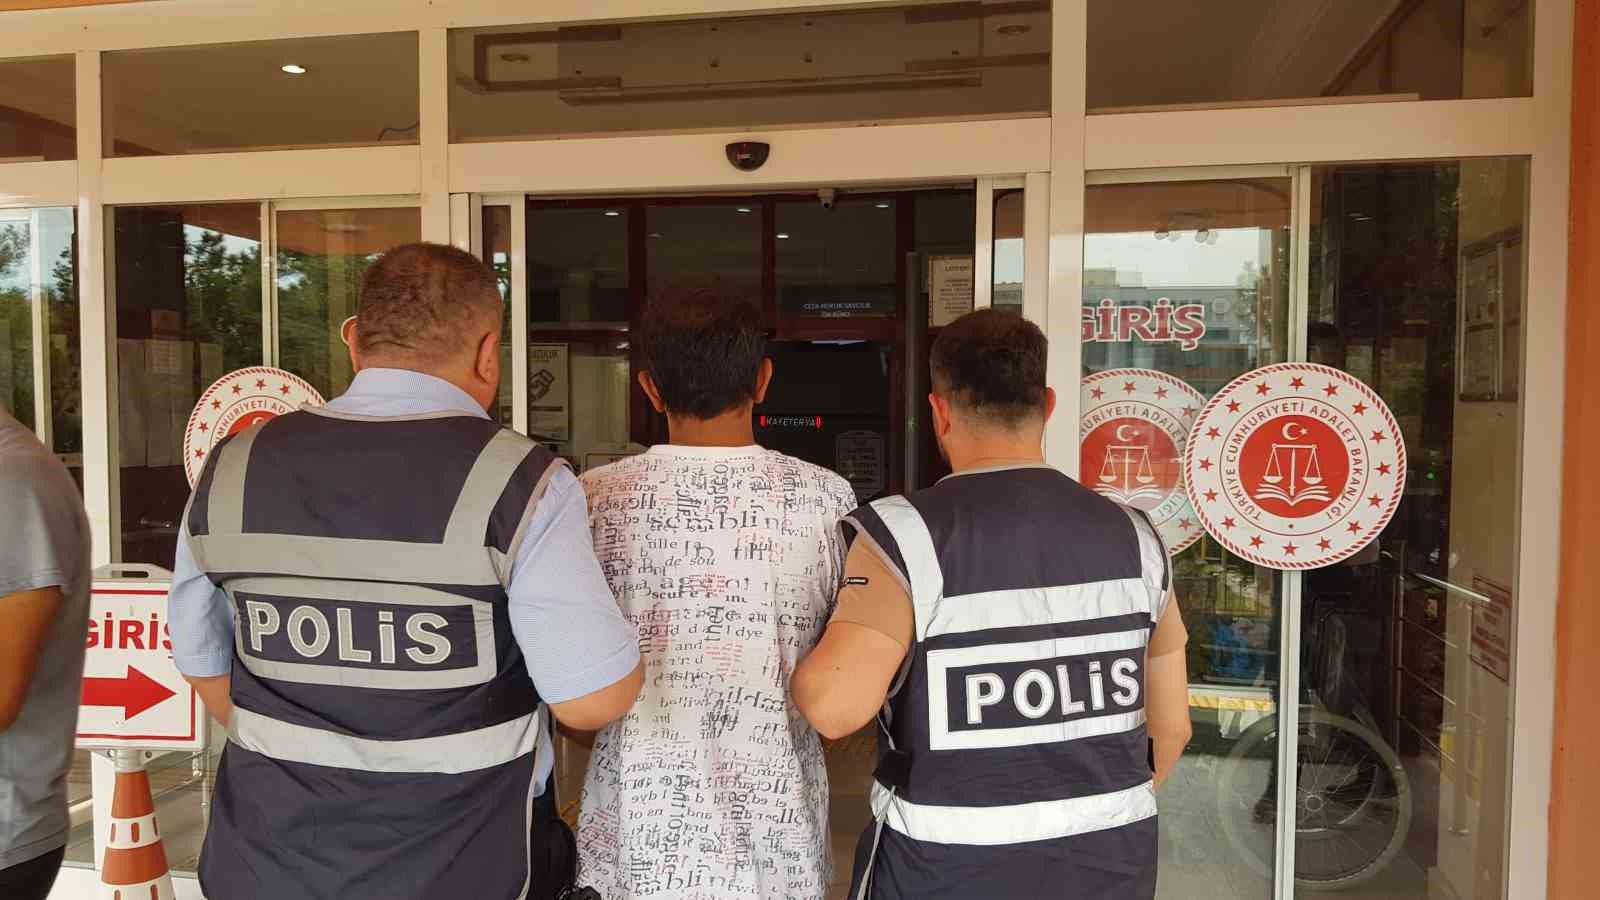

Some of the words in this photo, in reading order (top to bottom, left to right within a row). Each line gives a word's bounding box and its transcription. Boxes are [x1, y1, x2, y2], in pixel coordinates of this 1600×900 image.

[1226, 401, 1304, 463] CUMHURİYETİ
[1310, 405, 1356, 443] ADALET
[1226, 468, 1262, 520] TÜRKİYE
[1326, 448, 1362, 520] BAKANLIĞI
